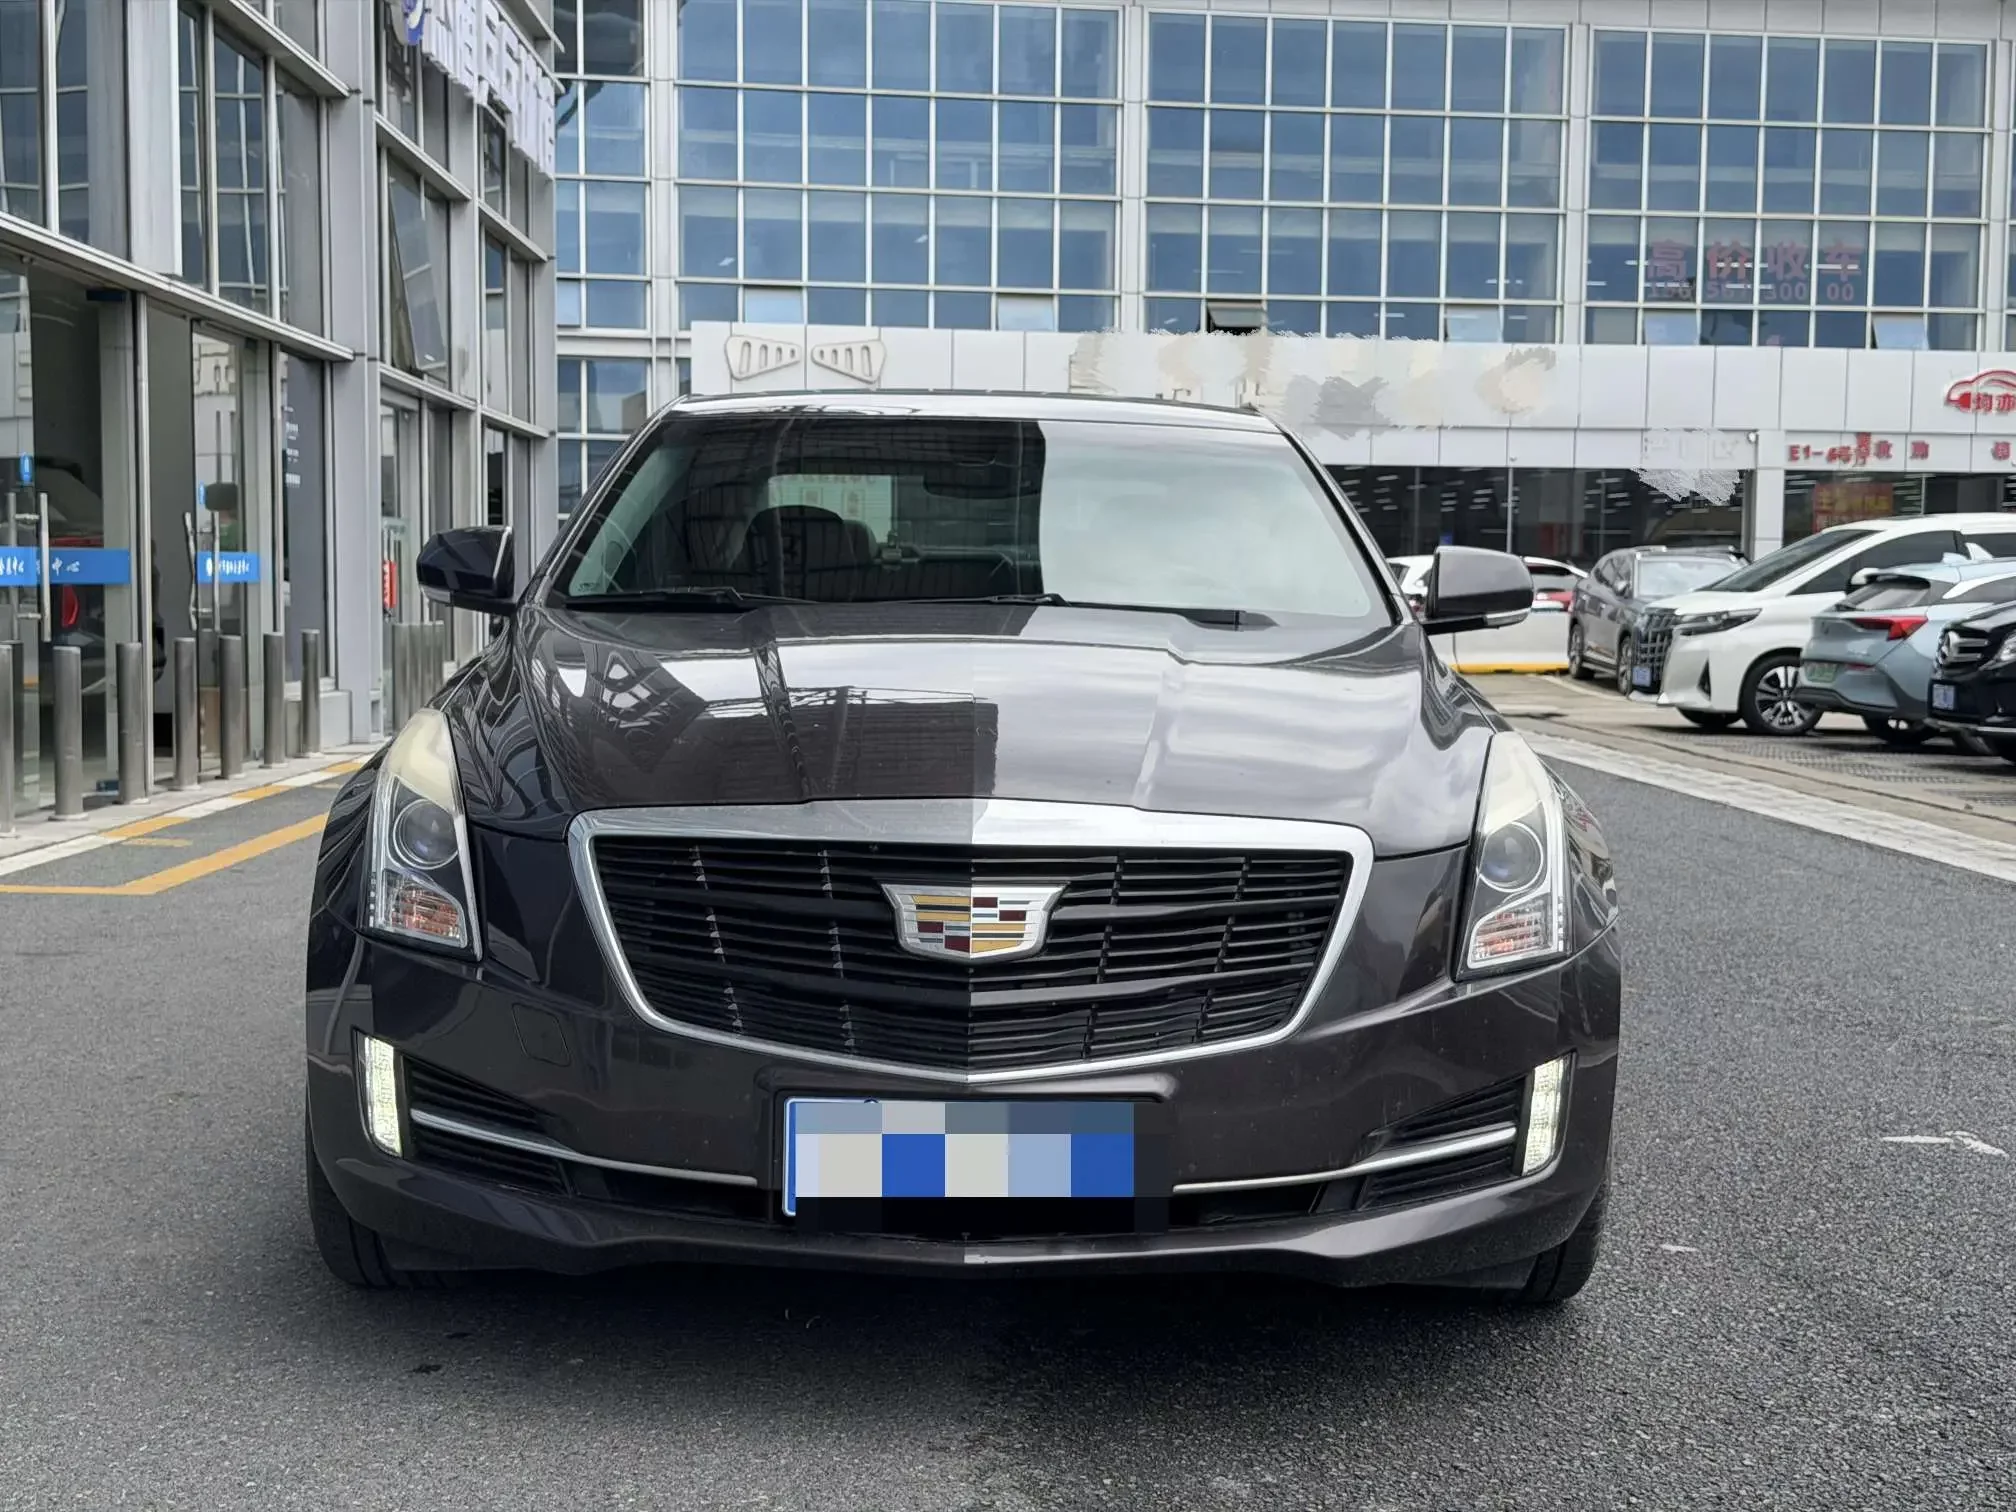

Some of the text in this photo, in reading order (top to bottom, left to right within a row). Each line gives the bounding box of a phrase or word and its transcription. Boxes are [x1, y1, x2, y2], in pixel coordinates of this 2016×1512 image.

[1648, 239, 1863, 283] 高价收车
[1826, 283, 1855, 302] 00
